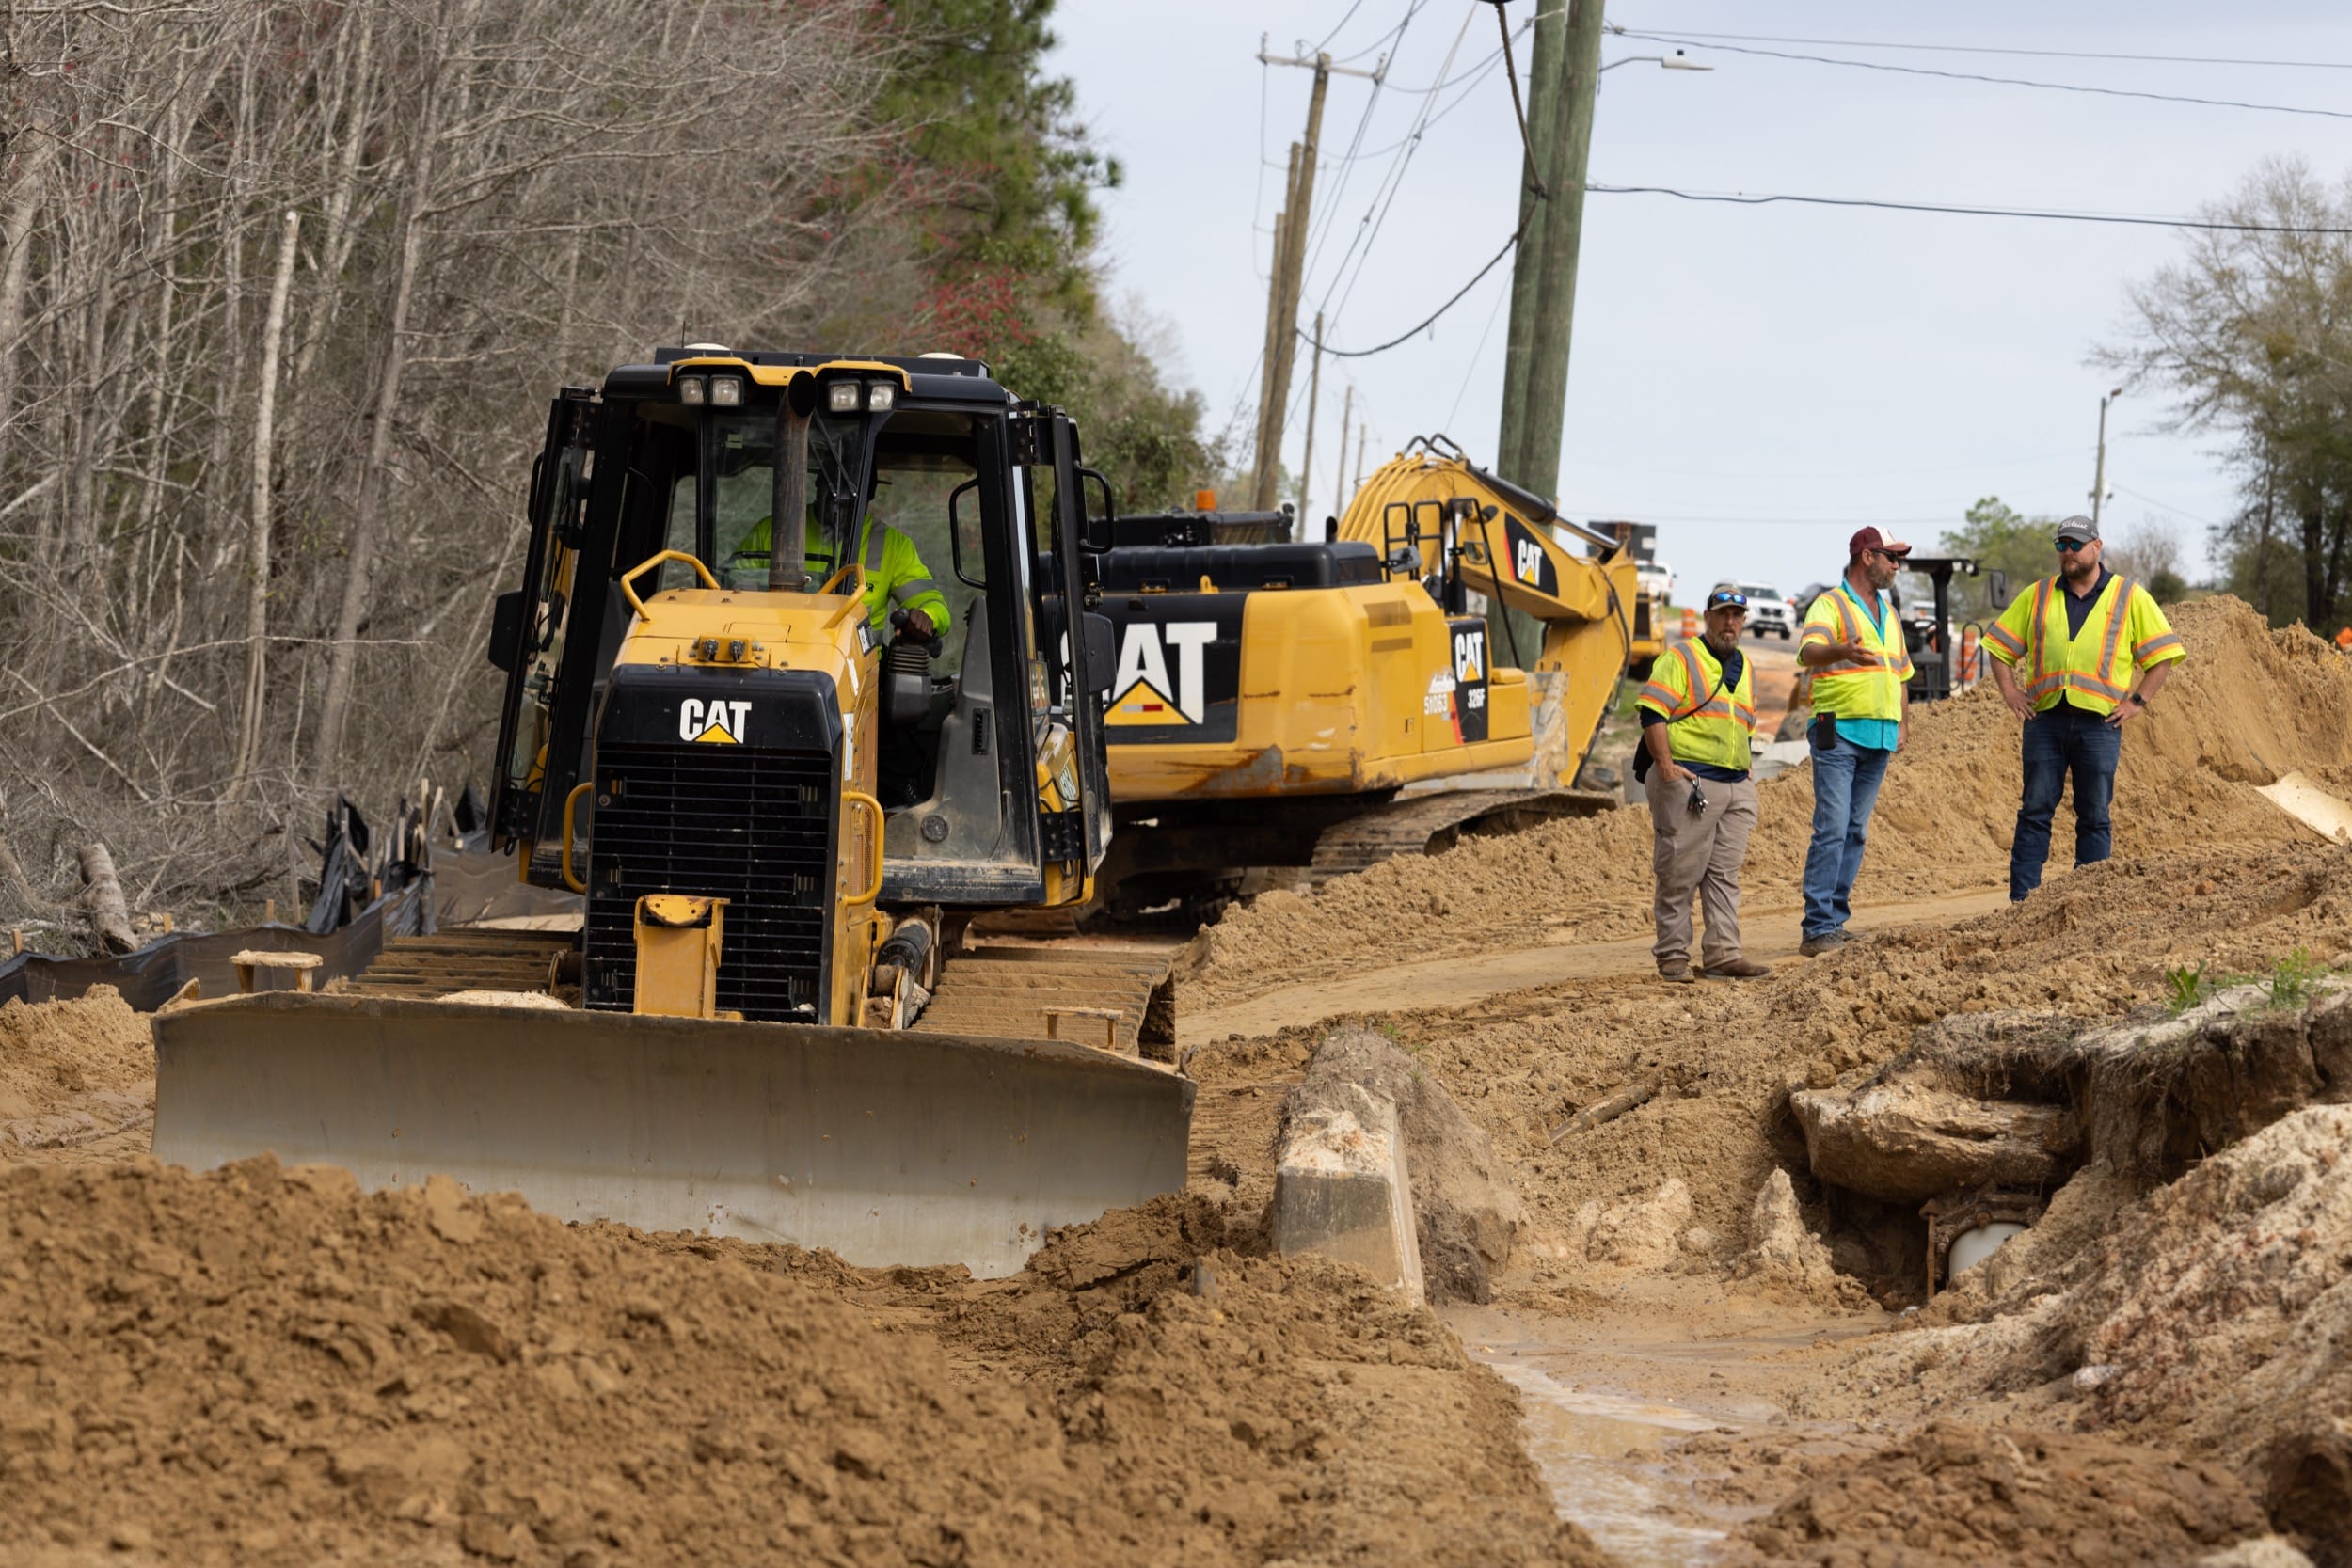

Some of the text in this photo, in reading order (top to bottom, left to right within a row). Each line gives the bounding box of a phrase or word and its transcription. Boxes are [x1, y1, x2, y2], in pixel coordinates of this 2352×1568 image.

[1518, 538, 1542, 587] CAT
[1454, 631, 1484, 683] CAT
[679, 698, 752, 744] CAT
